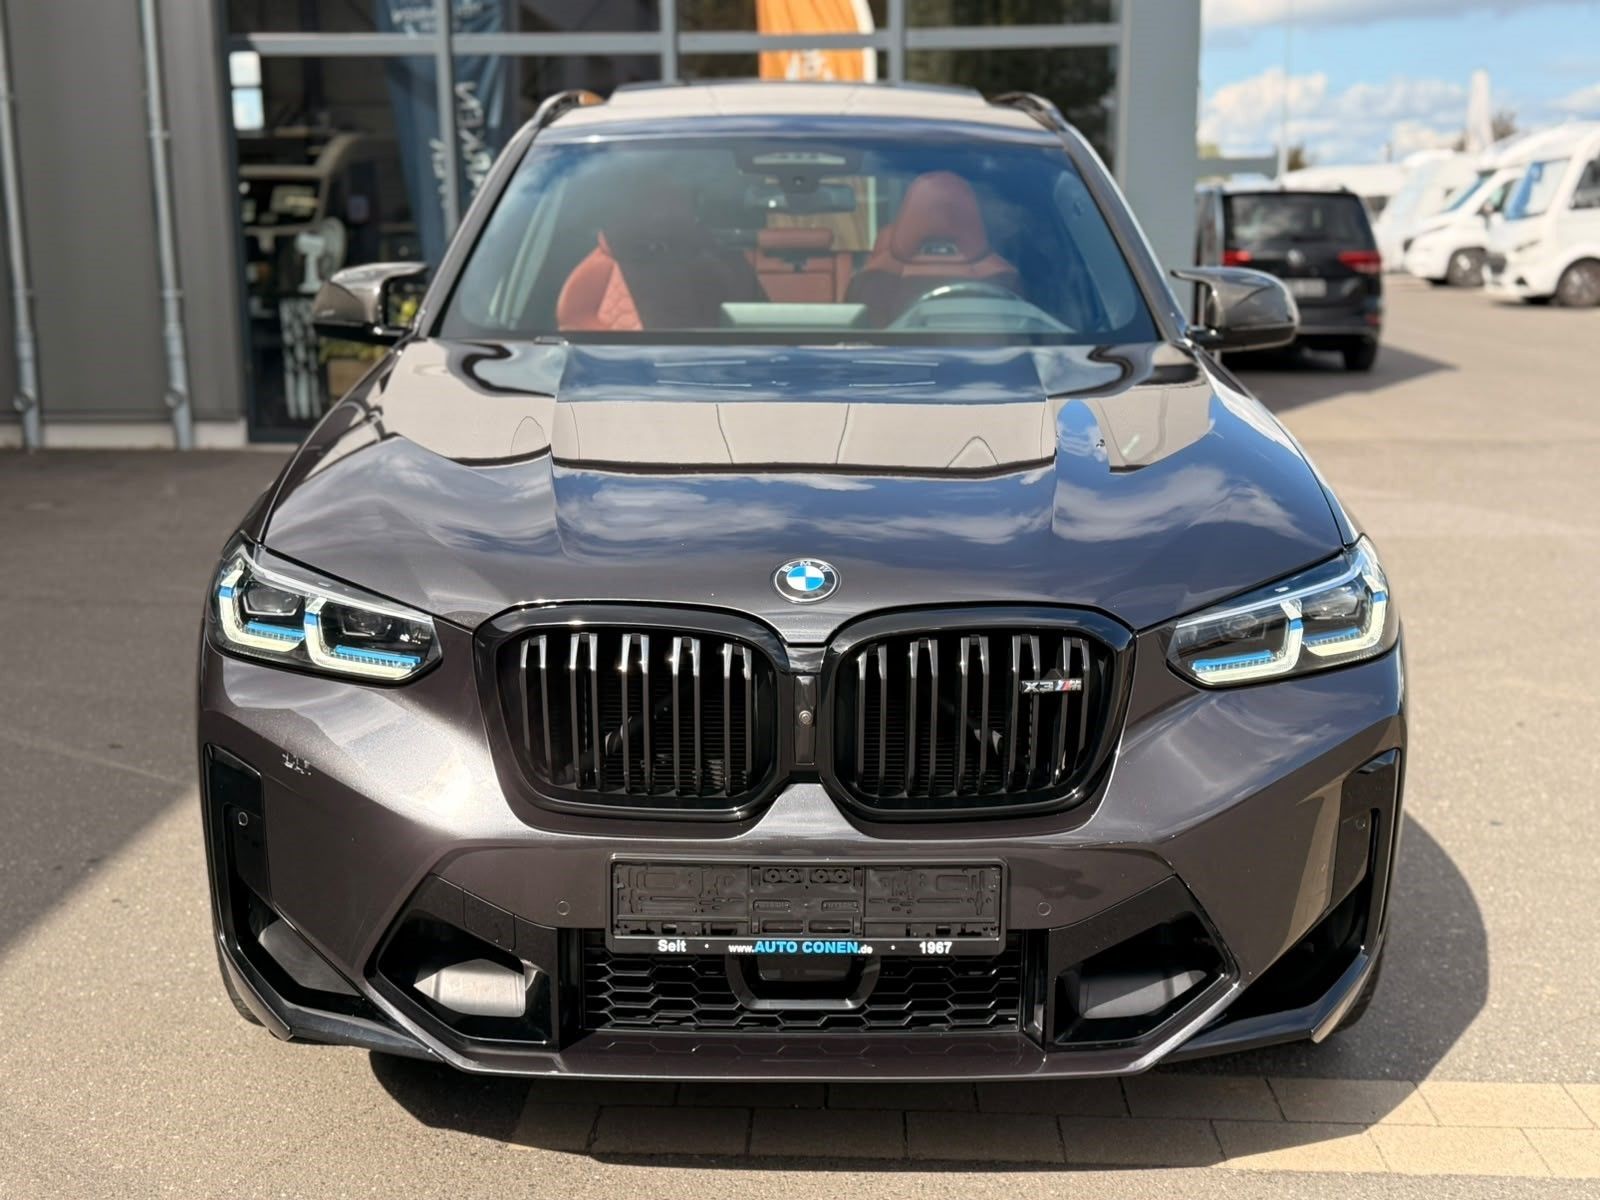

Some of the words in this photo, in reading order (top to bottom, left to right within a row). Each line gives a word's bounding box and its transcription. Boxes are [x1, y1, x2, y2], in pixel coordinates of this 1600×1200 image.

[781, 560, 832, 572] BMW
[1023, 681, 1054, 693] X3
[919, 941, 953, 954] 1967
